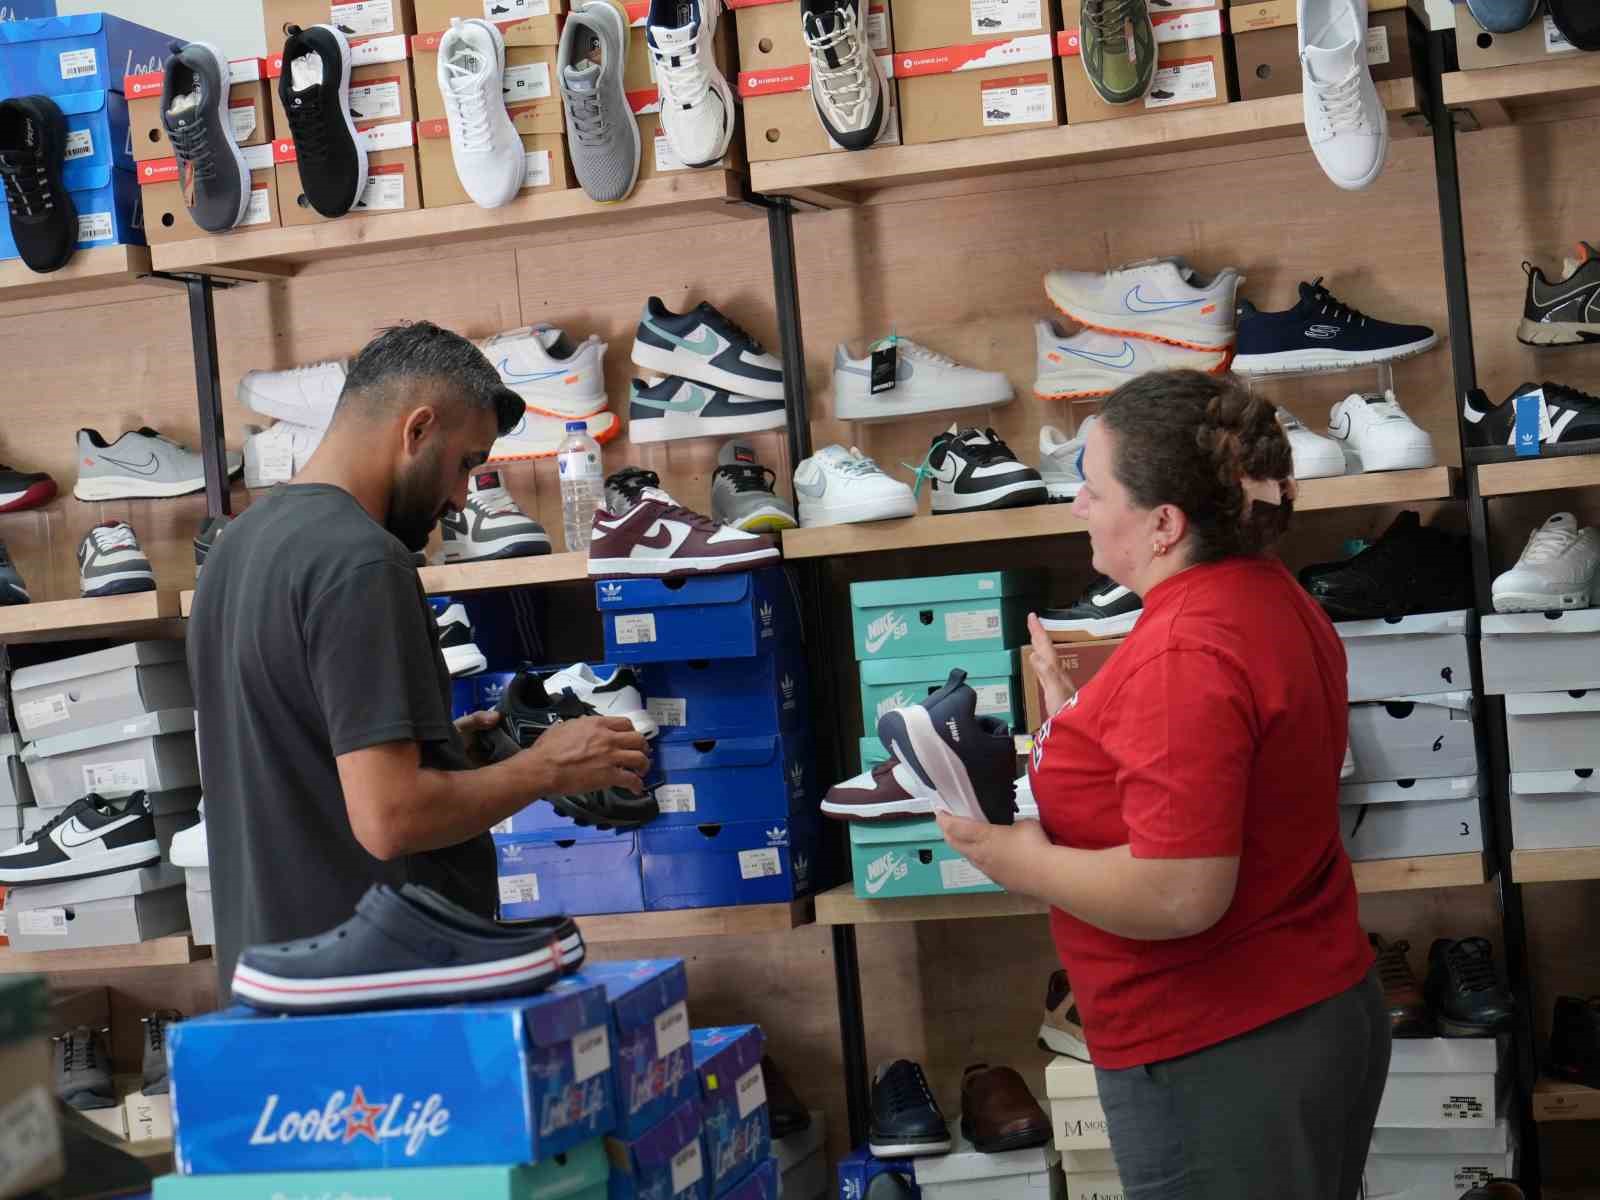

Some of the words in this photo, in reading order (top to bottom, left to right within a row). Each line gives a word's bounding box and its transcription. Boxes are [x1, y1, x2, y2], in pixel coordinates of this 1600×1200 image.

[1432, 735, 1445, 752] 6
[1459, 821, 1471, 836] 3
[250, 1090, 348, 1145] Look
[377, 1093, 449, 1157] Life
